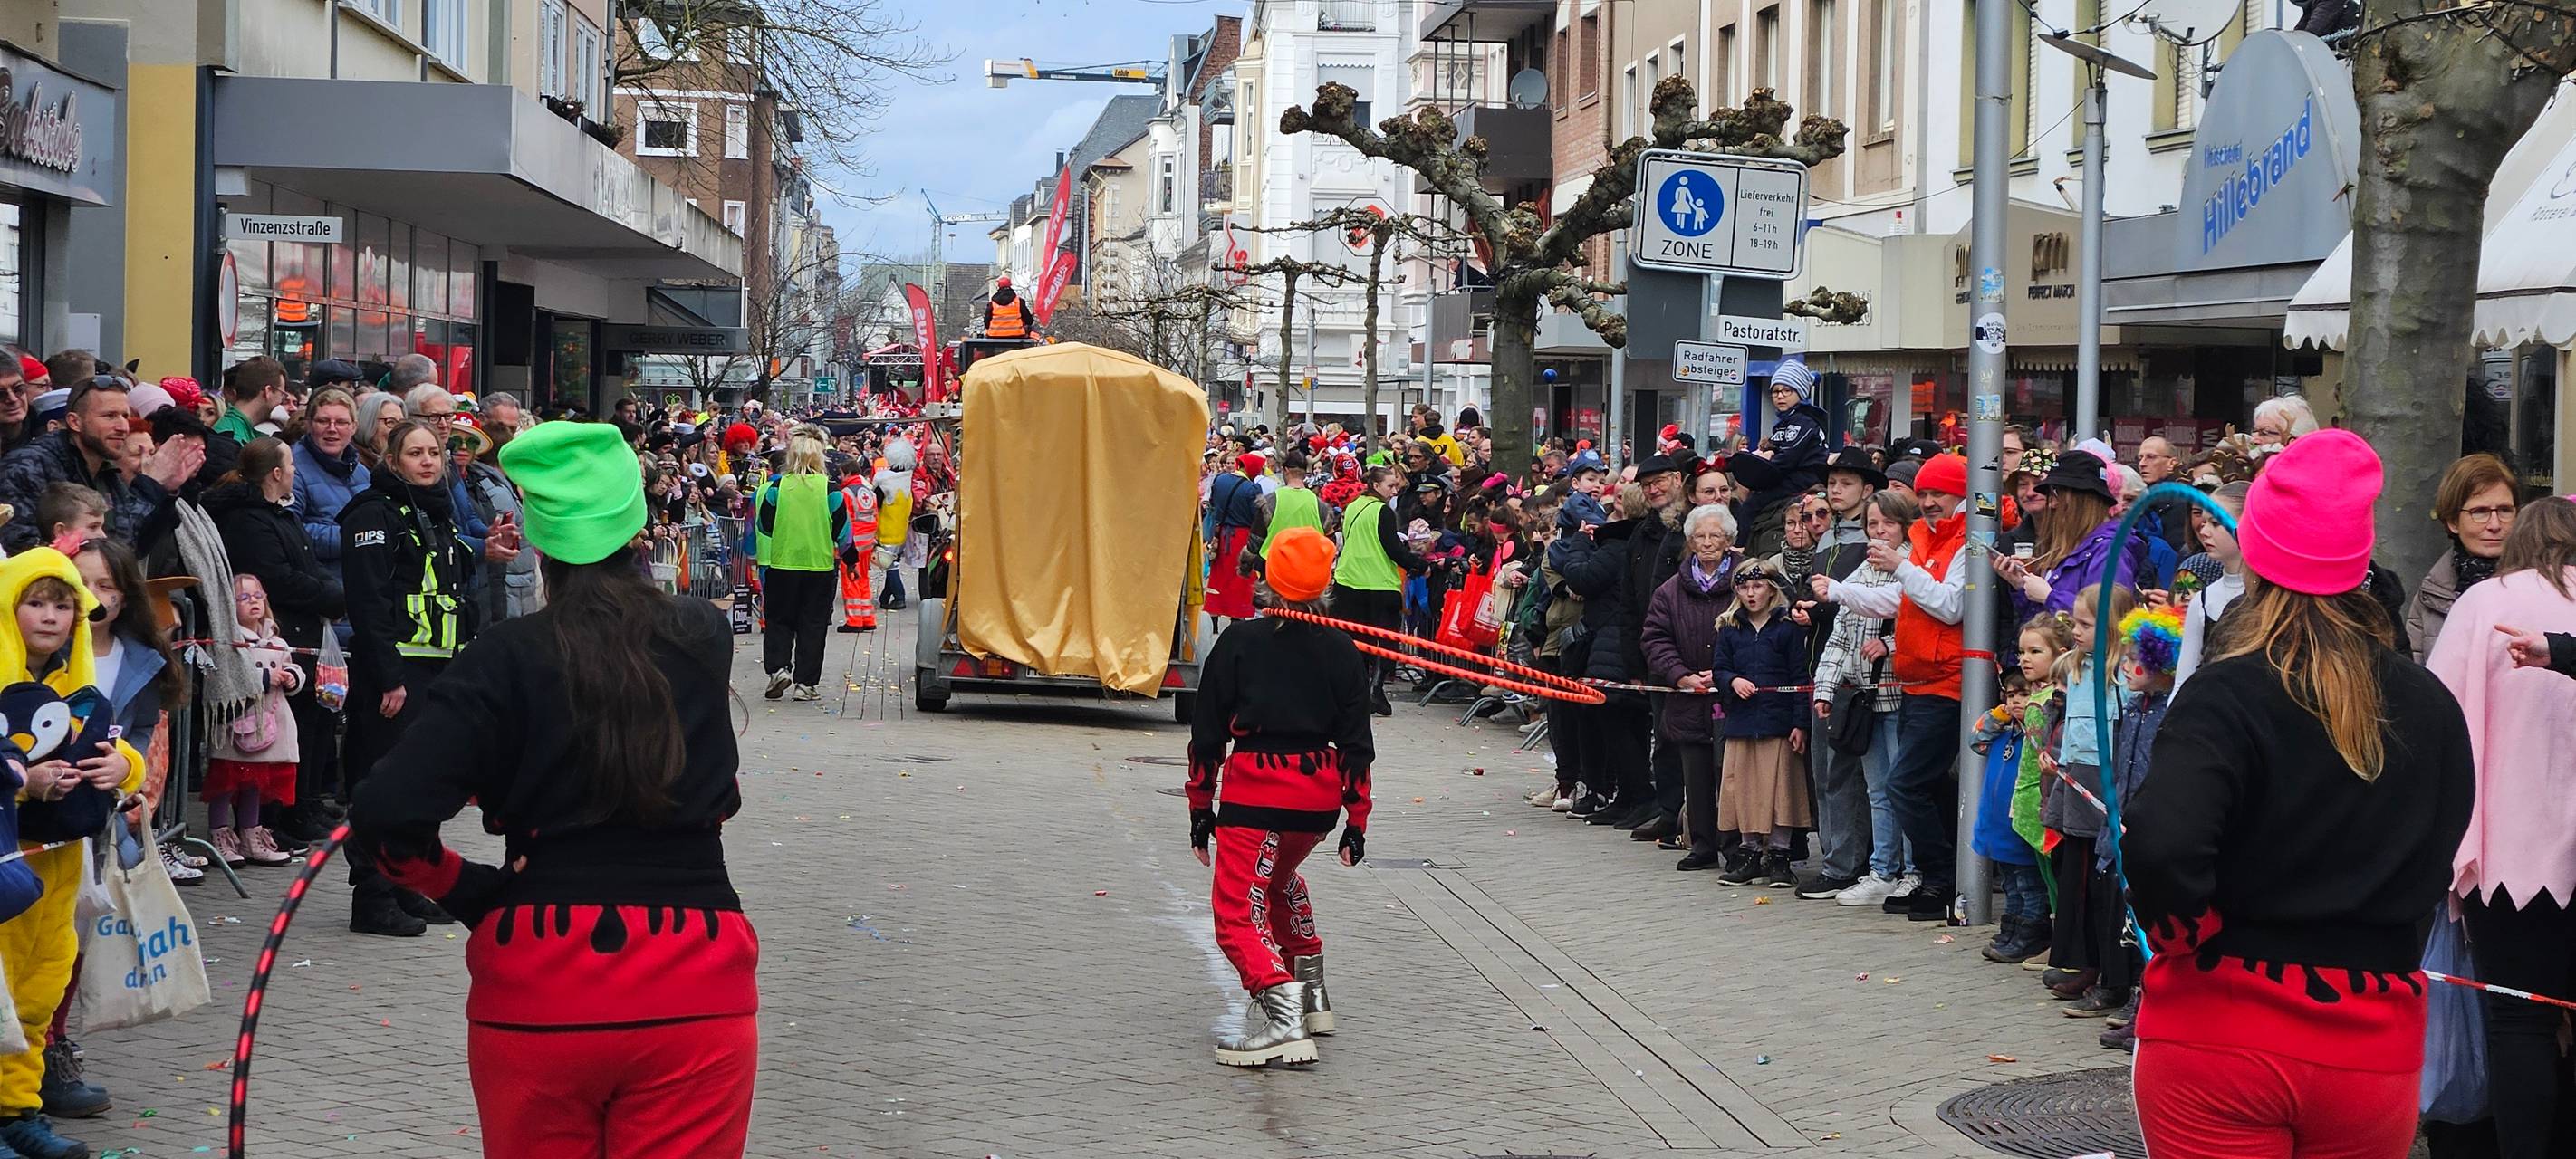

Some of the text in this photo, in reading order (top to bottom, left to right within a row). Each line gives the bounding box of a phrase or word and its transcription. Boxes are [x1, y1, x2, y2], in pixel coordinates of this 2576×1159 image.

[2203, 91, 2312, 255] Hillebrand
[1740, 189, 1795, 204] Lieferverkehr
[1759, 207, 1774, 217] frei
[240, 217, 332, 236] Vinzenzstraße
[1661, 239, 1714, 260] ZONE
[629, 331, 725, 346] GERRY WEBER
[1724, 321, 1801, 343] Pastoratstr.
[1684, 350, 1738, 364] Radfahrer
[364, 530, 385, 541] IPS
[97, 915, 141, 938] Ga
[124, 963, 167, 989] drn
